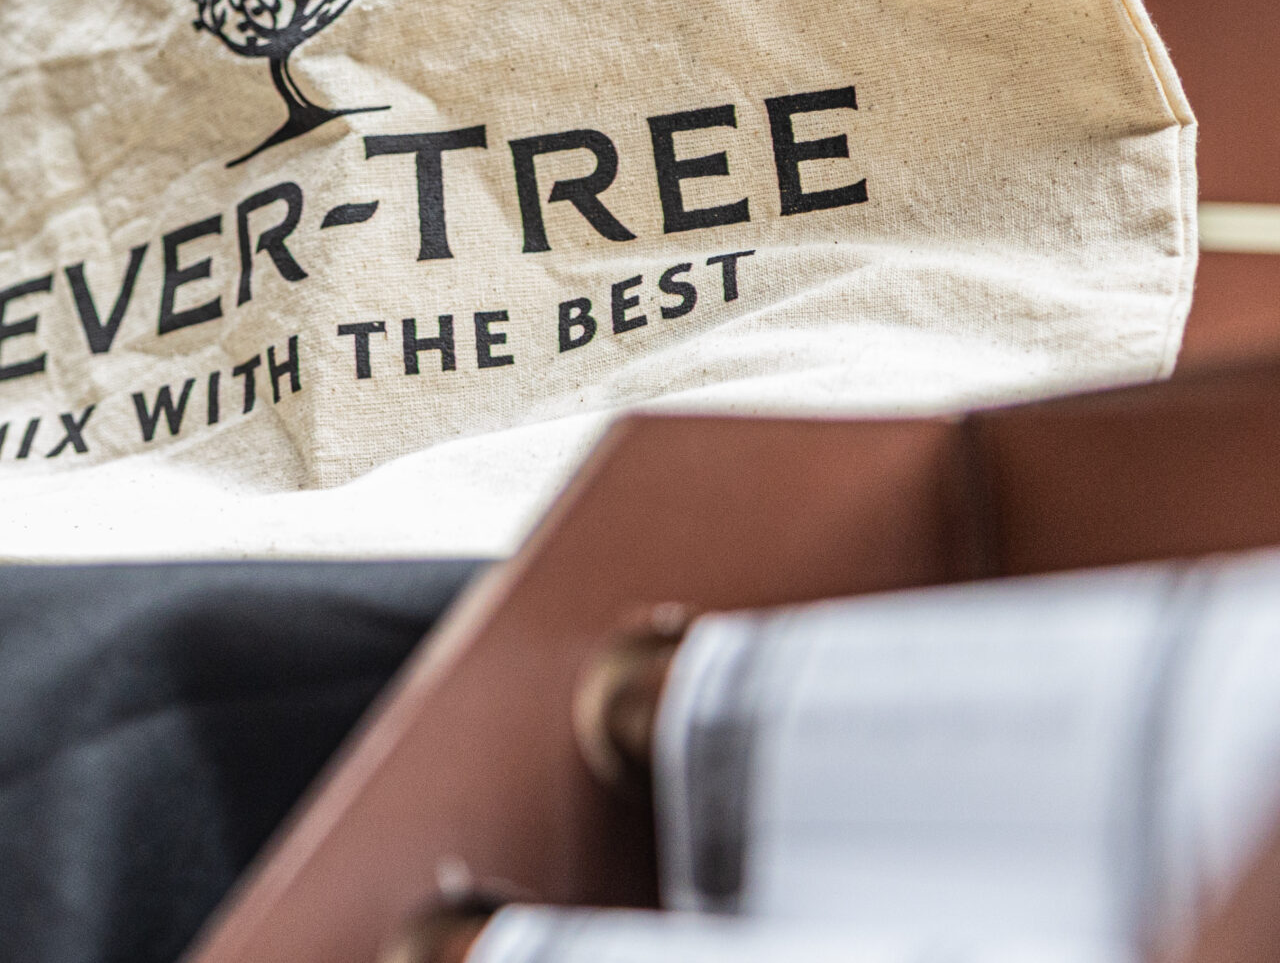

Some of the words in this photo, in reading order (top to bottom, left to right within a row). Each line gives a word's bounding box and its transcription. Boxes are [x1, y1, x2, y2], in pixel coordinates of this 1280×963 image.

[131, 335, 303, 442] WITH
[337, 310, 515, 379] THE
[558, 249, 756, 353] BEST
